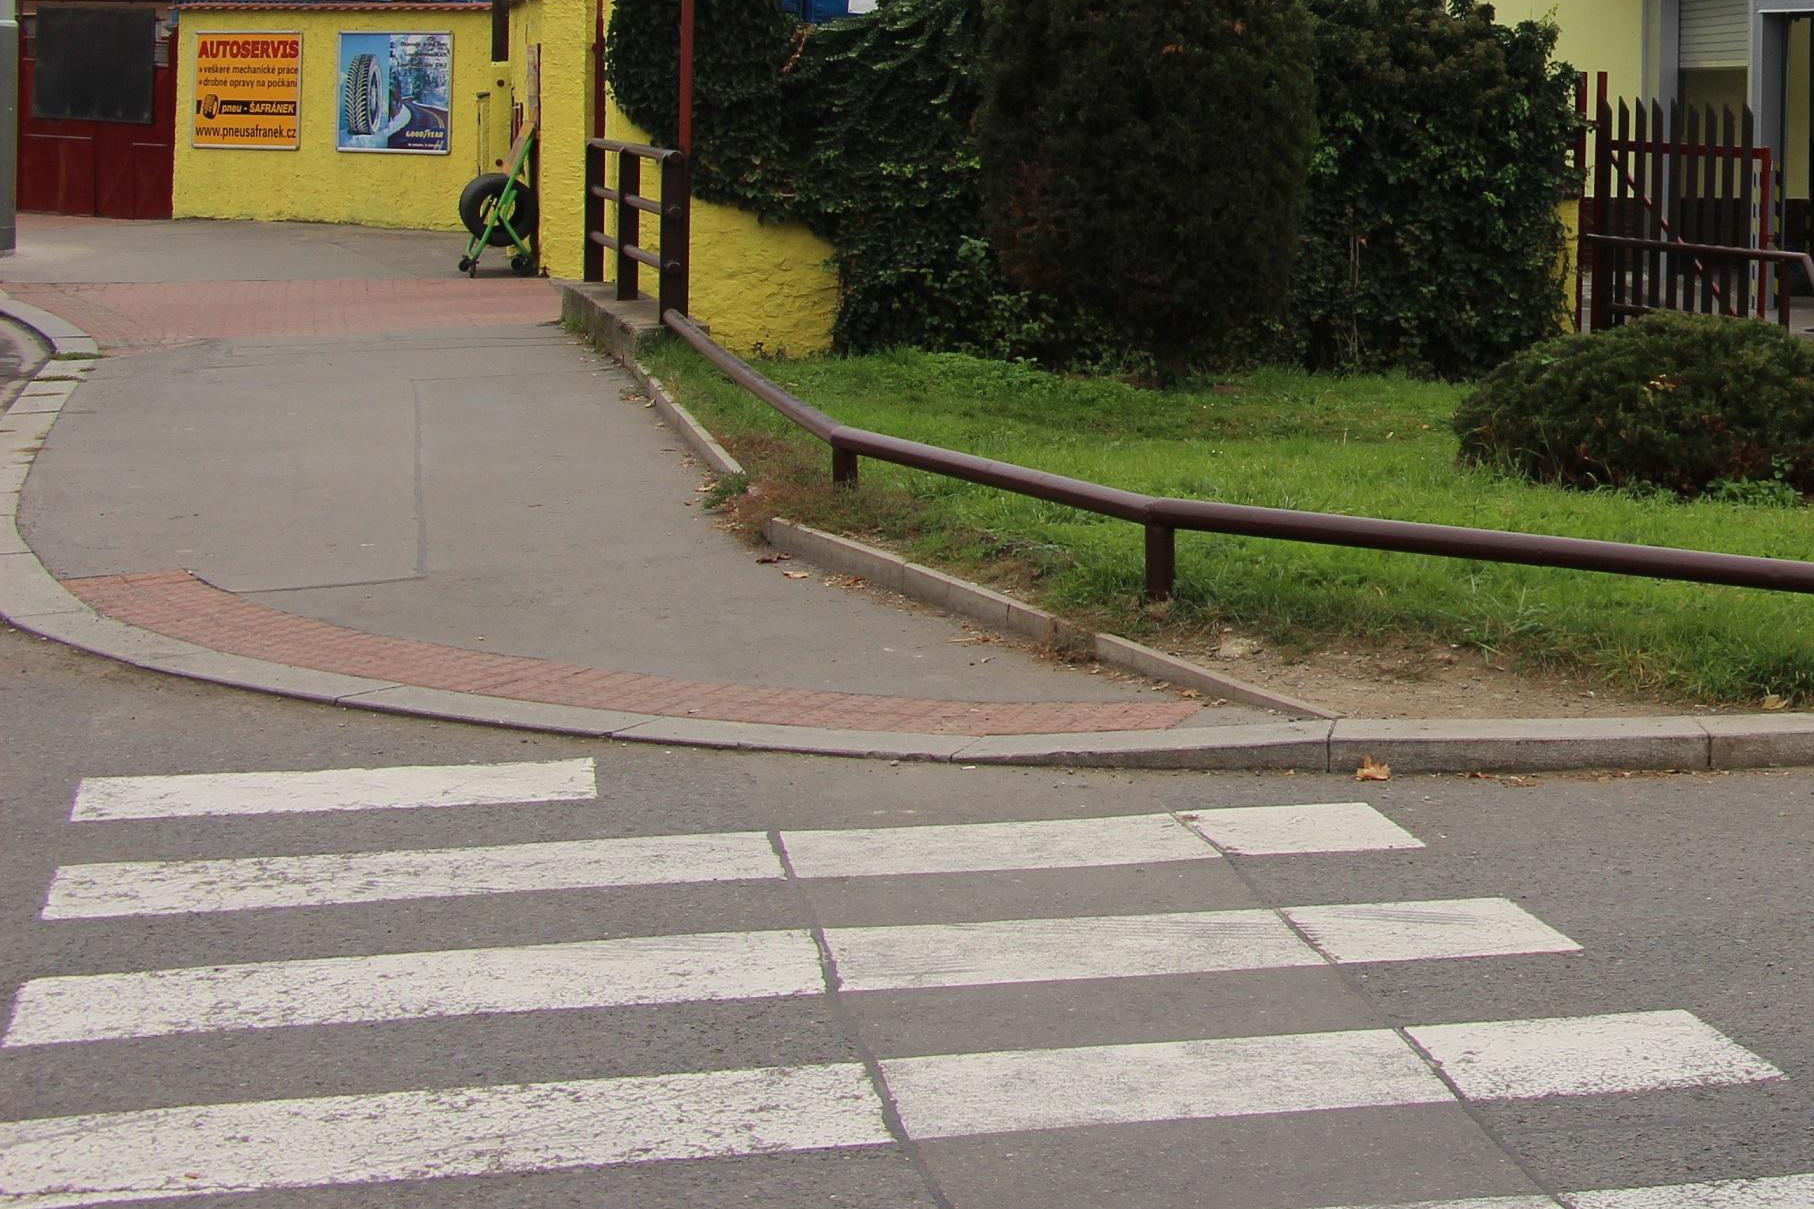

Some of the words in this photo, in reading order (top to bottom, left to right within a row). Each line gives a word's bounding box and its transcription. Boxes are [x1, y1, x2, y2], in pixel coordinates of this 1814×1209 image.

[198, 40, 299, 59] AUTOSERVIS
[203, 65, 230, 74] veškeré
[232, 65, 276, 74] mechanické
[278, 65, 298, 76] práce
[203, 77, 228, 87] drobné
[229, 79, 255, 88] opravy
[222, 103, 242, 113] pneu
[249, 101, 295, 114] ŠAFRÁNEK
[196, 123, 297, 139] www.pneusafranek.cz
[405, 130, 444, 139] GOODYEAR
